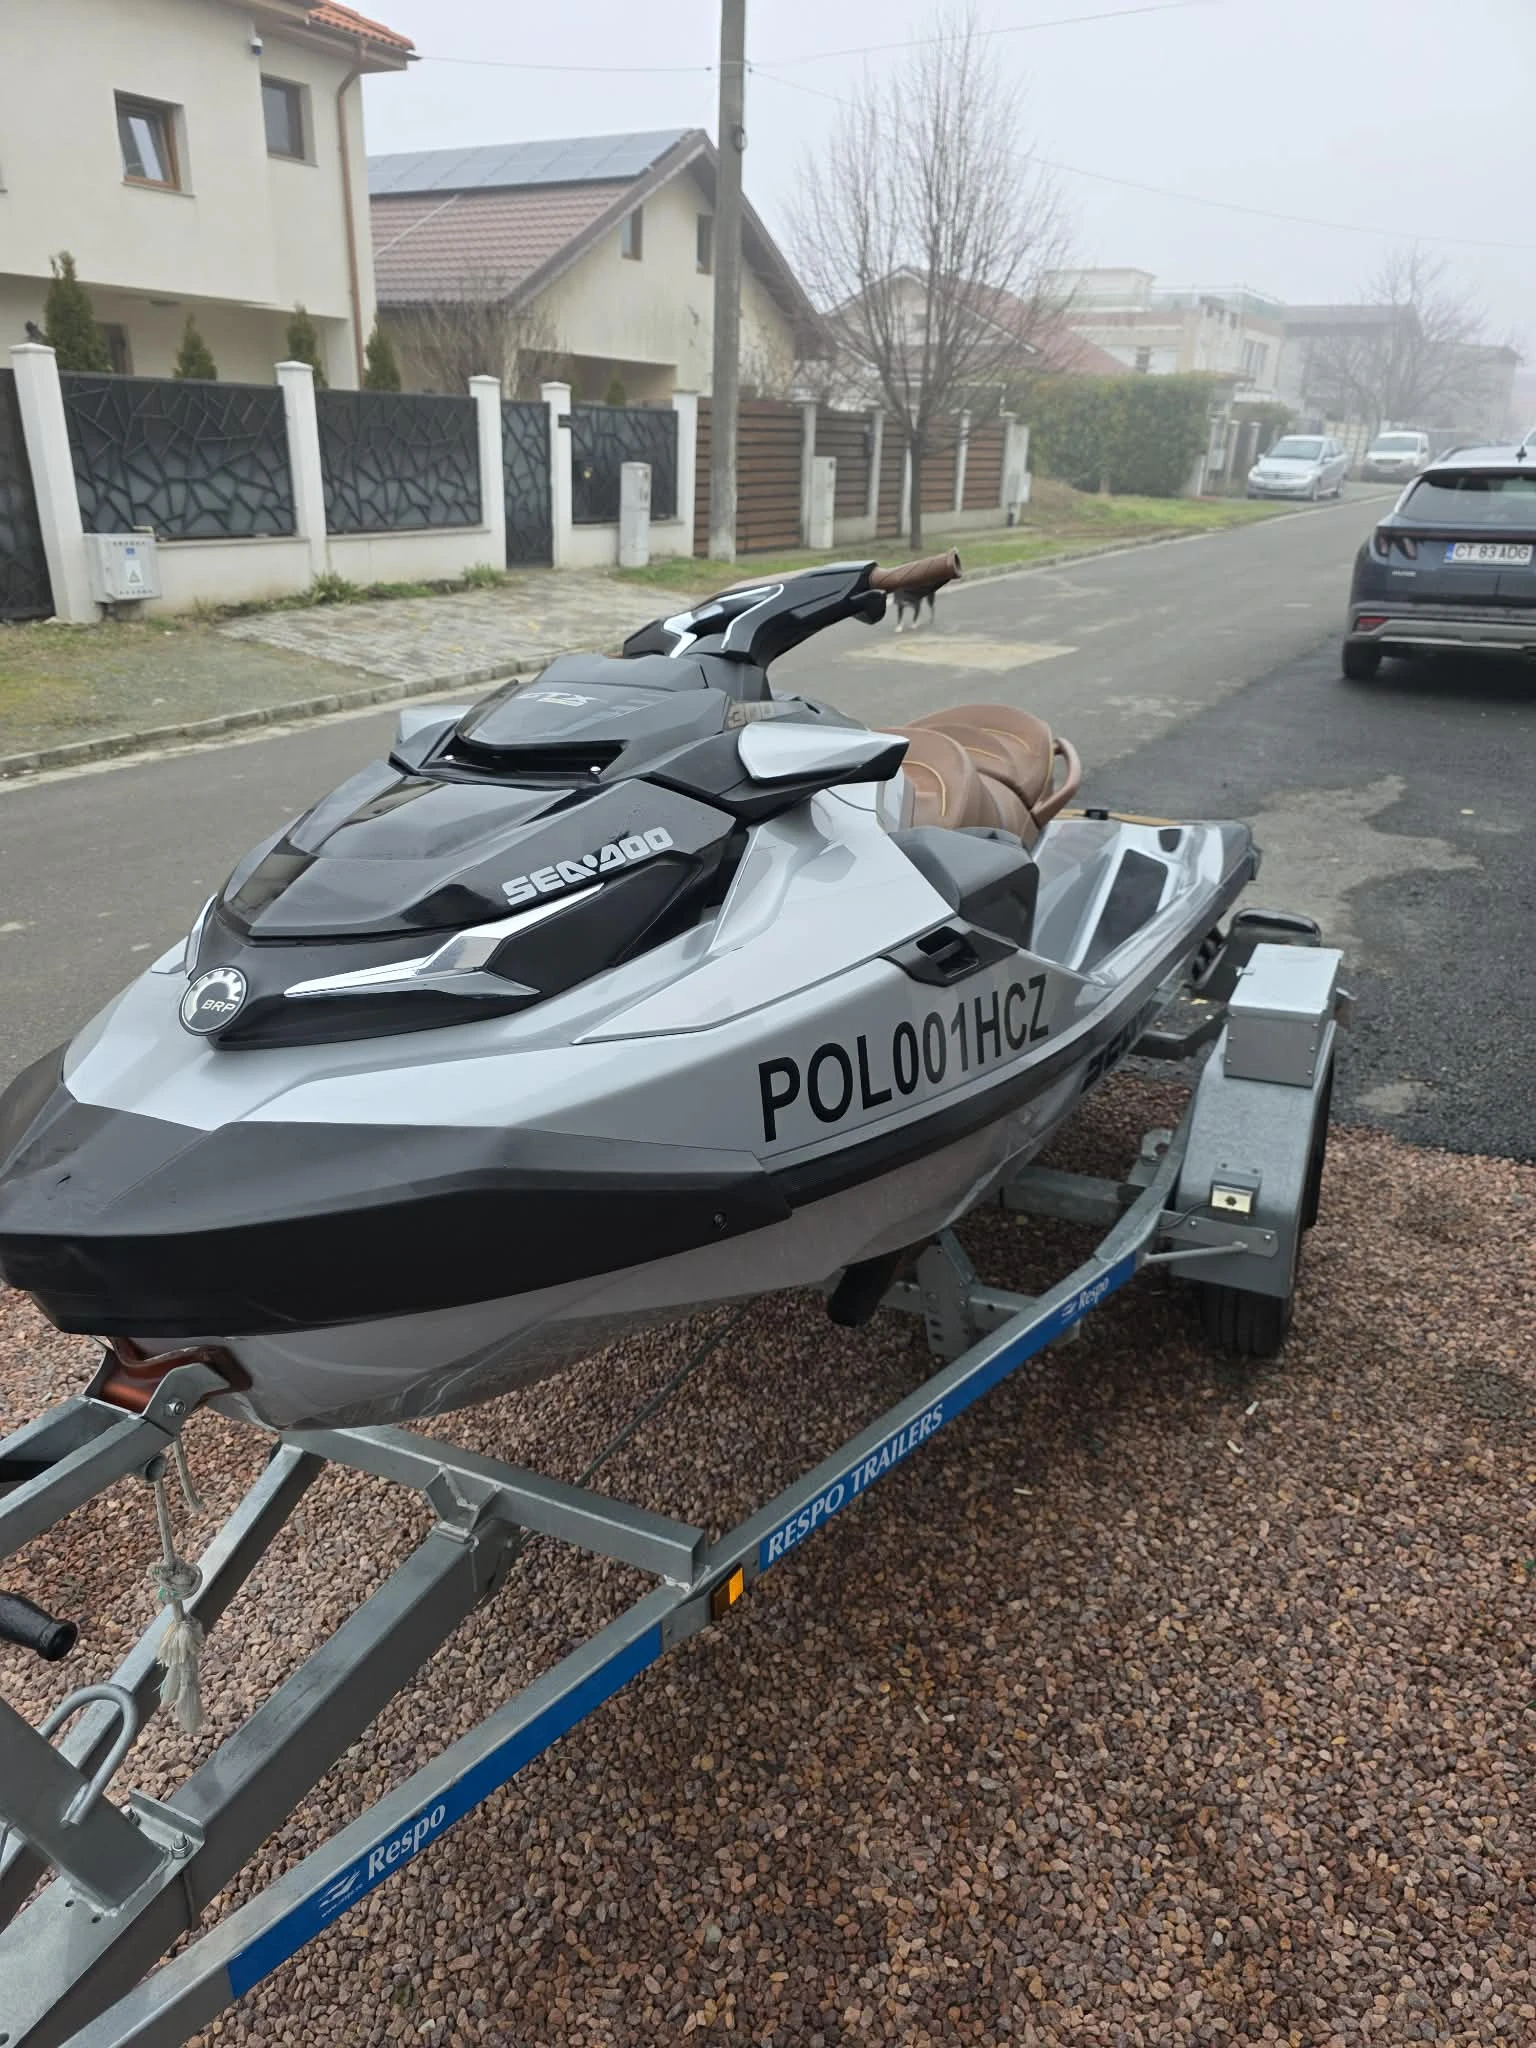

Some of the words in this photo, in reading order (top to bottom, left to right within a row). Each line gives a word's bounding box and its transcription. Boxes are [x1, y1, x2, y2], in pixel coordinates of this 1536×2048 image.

[1456, 543, 1475, 558] CT
[1480, 544, 1497, 560] 83
[1499, 545, 1530, 561] ADG
[201, 999, 236, 1013] BRP
[757, 973, 1050, 1143] POL001HCZ
[767, 1483, 845, 1564] RESPO
[851, 1403, 944, 1494] TRAILERS
[368, 1804, 446, 1881] Respo
